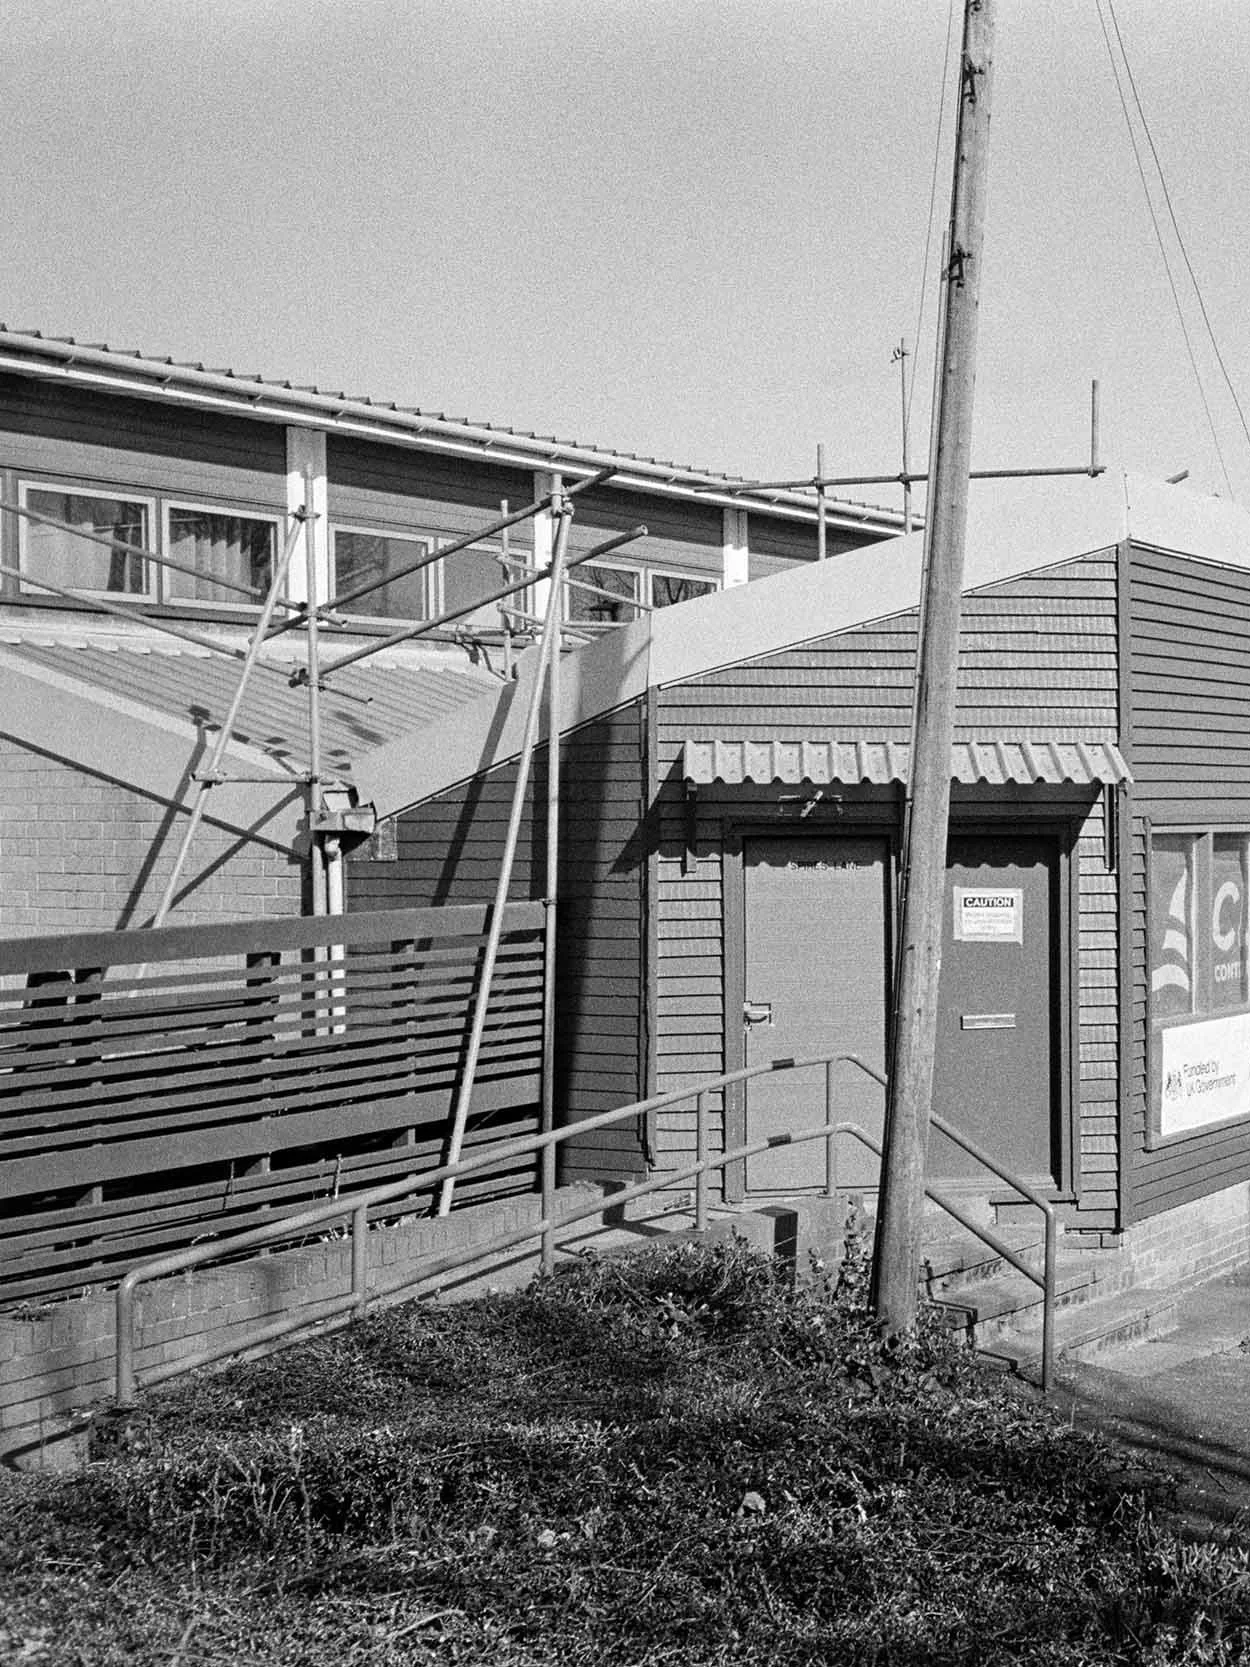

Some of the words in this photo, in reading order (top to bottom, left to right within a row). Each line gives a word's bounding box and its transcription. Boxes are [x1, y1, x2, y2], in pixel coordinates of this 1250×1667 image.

[966, 898, 1011, 907] CAUTION
[1183, 1060, 1210, 1078] Funded
[1211, 1059, 1220, 1075] by
[1196, 1073, 1236, 1094] Government
